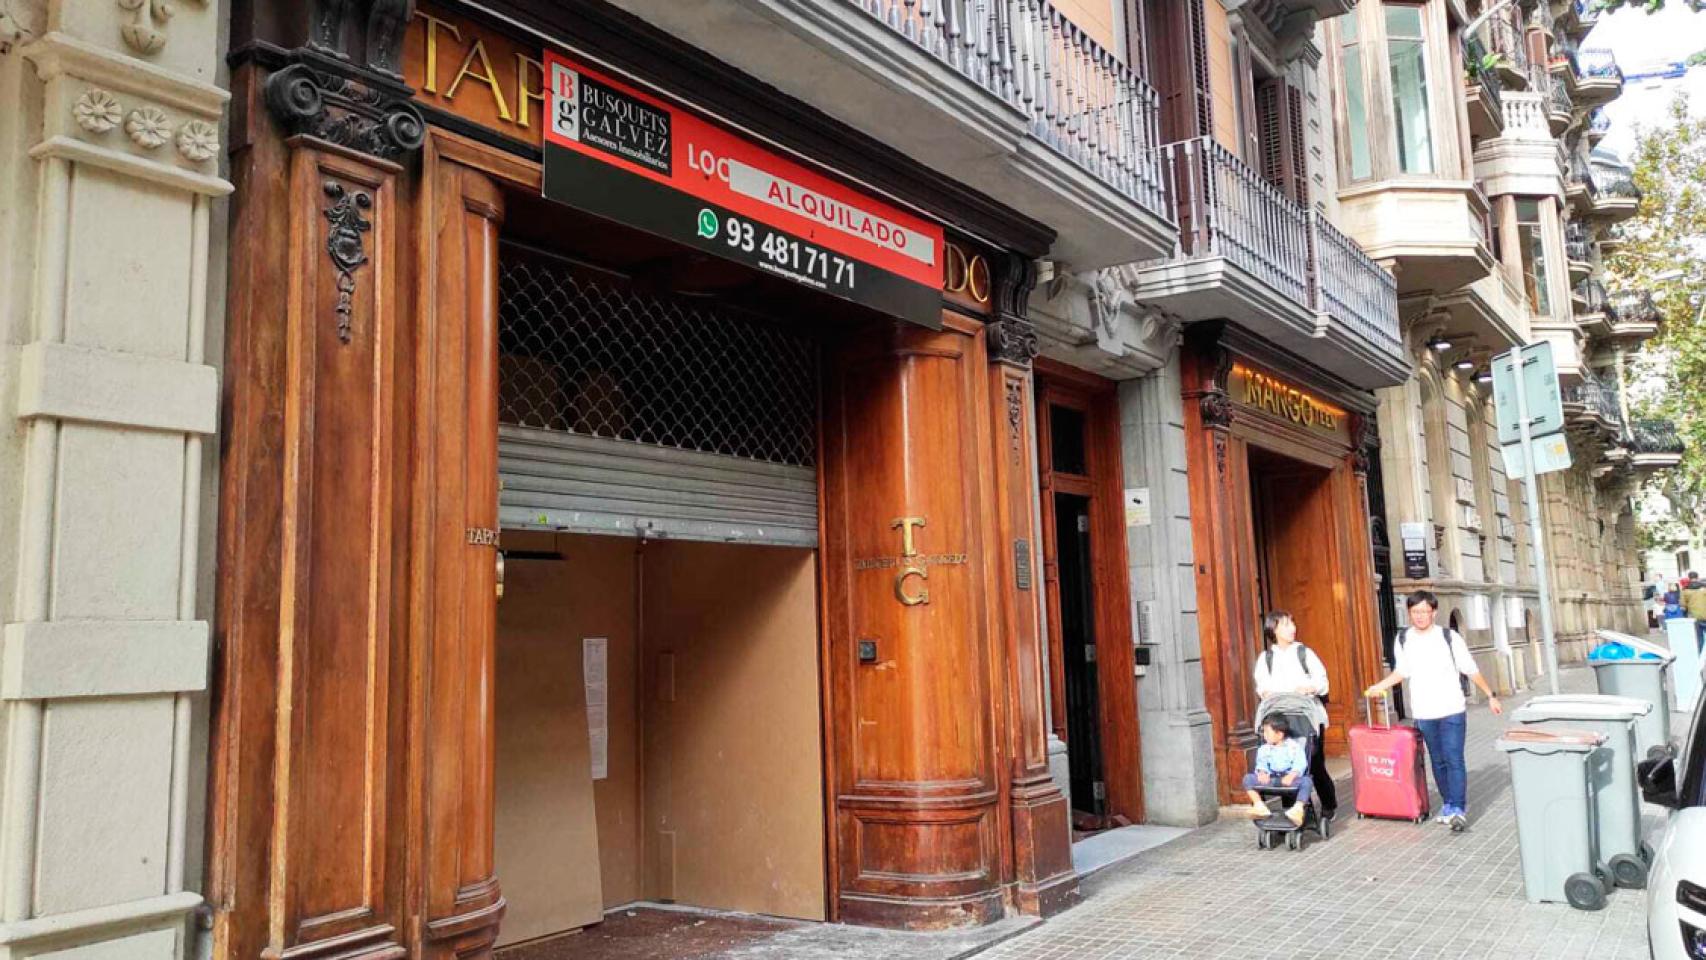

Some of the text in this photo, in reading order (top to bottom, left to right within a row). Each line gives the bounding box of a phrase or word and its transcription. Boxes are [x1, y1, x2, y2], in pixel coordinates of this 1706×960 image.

[559, 72, 574, 98] B
[583, 84, 667, 136] BUSQUETS
[582, 107, 667, 156] GALVEZ
[582, 127, 668, 169] Asesores Inmobiliarios
[768, 181, 907, 248] ALQUILADO
[726, 217, 855, 288] 93 481 71 71
[943, 241, 991, 302] DO
[1243, 366, 1312, 426] MANGO
[889, 516, 926, 557] T
[894, 567, 928, 607] G
